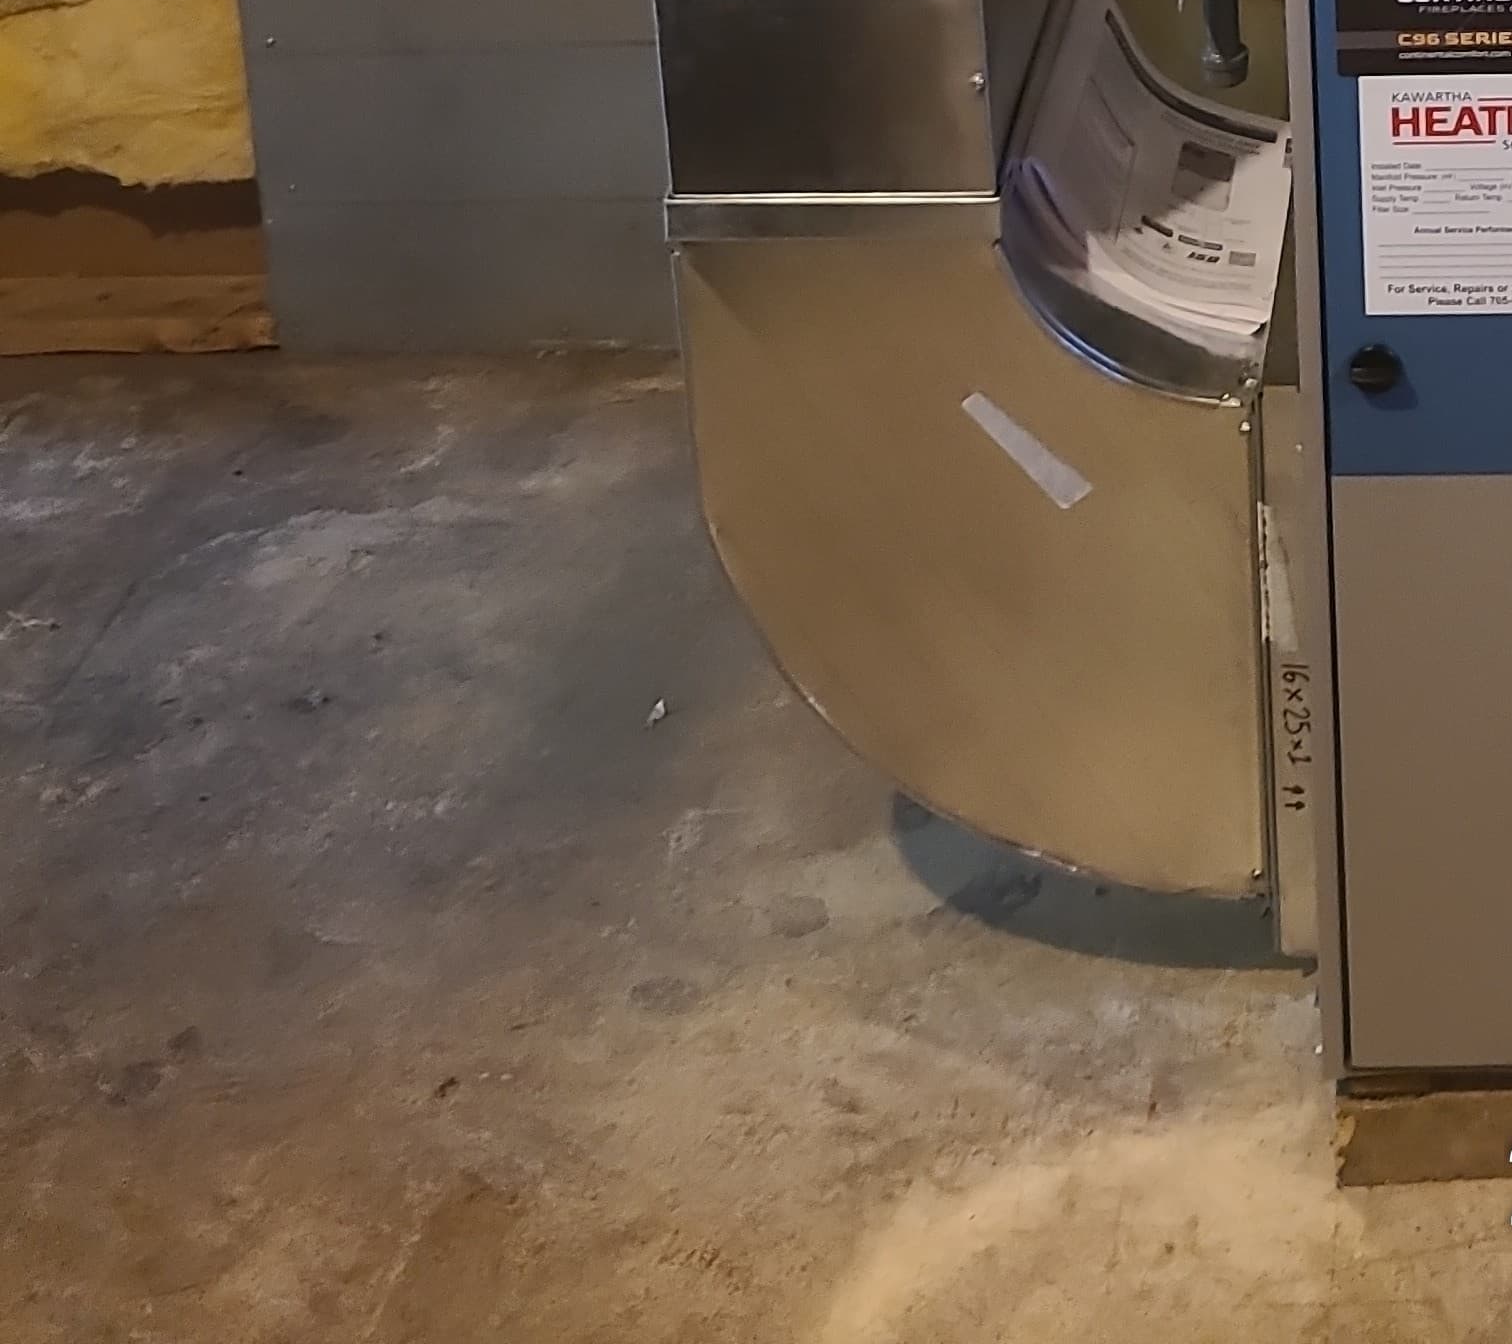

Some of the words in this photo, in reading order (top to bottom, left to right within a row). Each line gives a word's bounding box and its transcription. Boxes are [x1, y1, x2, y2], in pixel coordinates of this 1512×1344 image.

[1419, 4, 1506, 13] FIREPLACES
[1397, 32, 1442, 46] C96
[1391, 91, 1473, 103] KAWARTHA
[1414, 226, 1442, 234] Annual
[1387, 284, 1405, 293] For
[1454, 283, 1494, 294] Repairs
[1497, 285, 1508, 293] or
[1428, 296, 1463, 306] Please
[1466, 296, 1488, 305] Call
